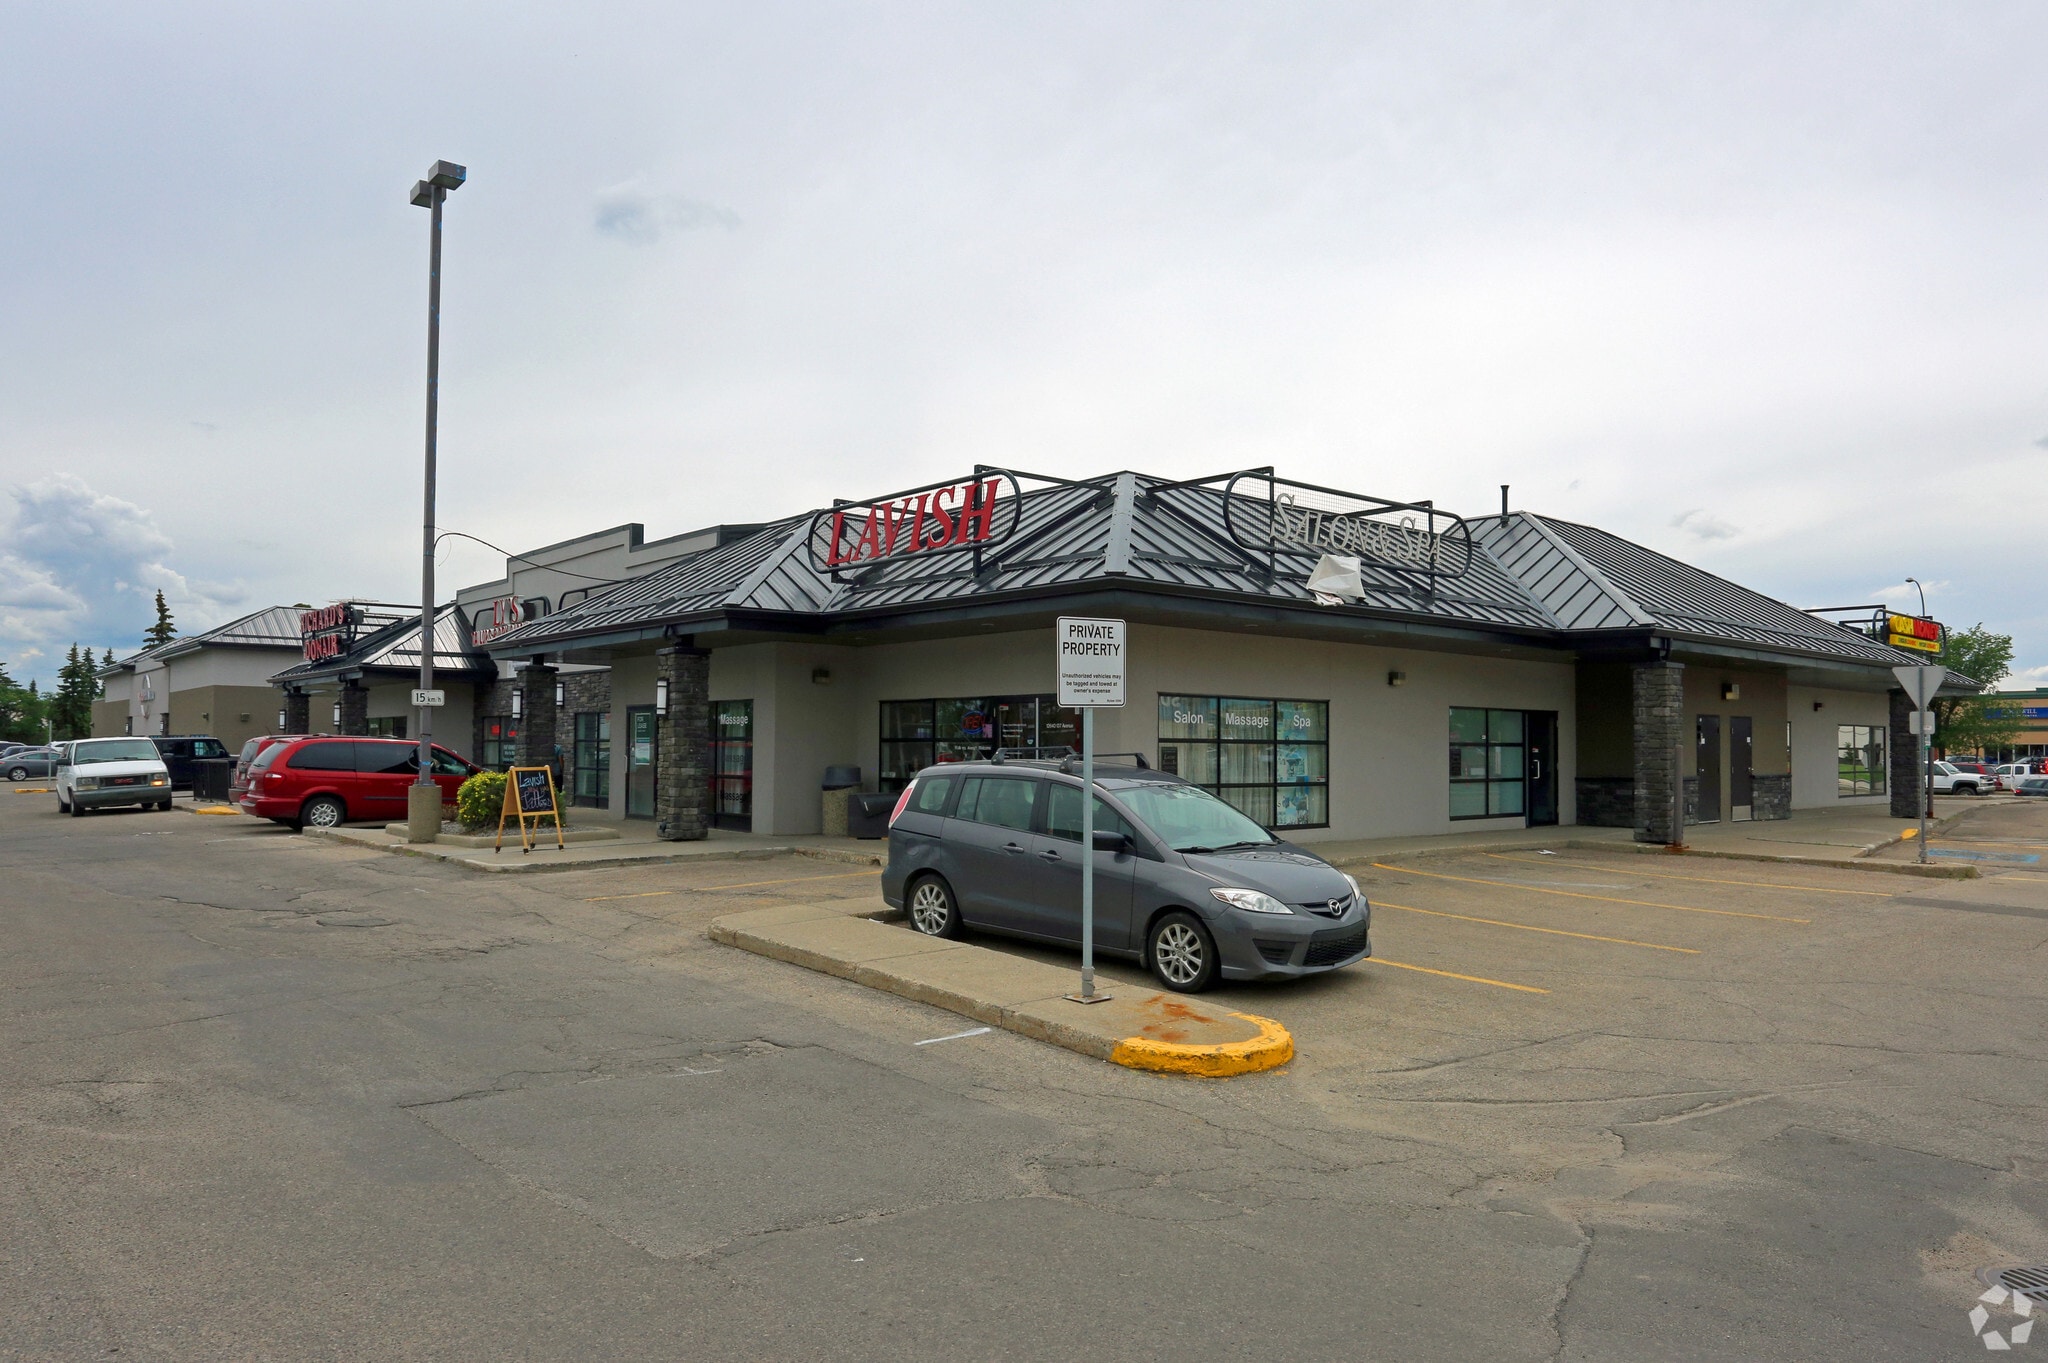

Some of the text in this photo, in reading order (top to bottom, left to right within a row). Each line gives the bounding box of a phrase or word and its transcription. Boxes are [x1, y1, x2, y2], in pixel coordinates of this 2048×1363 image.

[825, 478, 1003, 566] LAVISH
[1269, 492, 1442, 564] SALON & SPA
[300, 602, 344, 633] RICHARD'S
[1069, 624, 1114, 639] PRIVATE
[303, 634, 339, 661] DONAIR
[1062, 641, 1121, 657] PROPERTY
[416, 692, 426, 703] 15
[720, 713, 749, 727] Massage
[1173, 710, 1311, 729] Salon Massage Spa
[518, 771, 545, 788] Lavish
